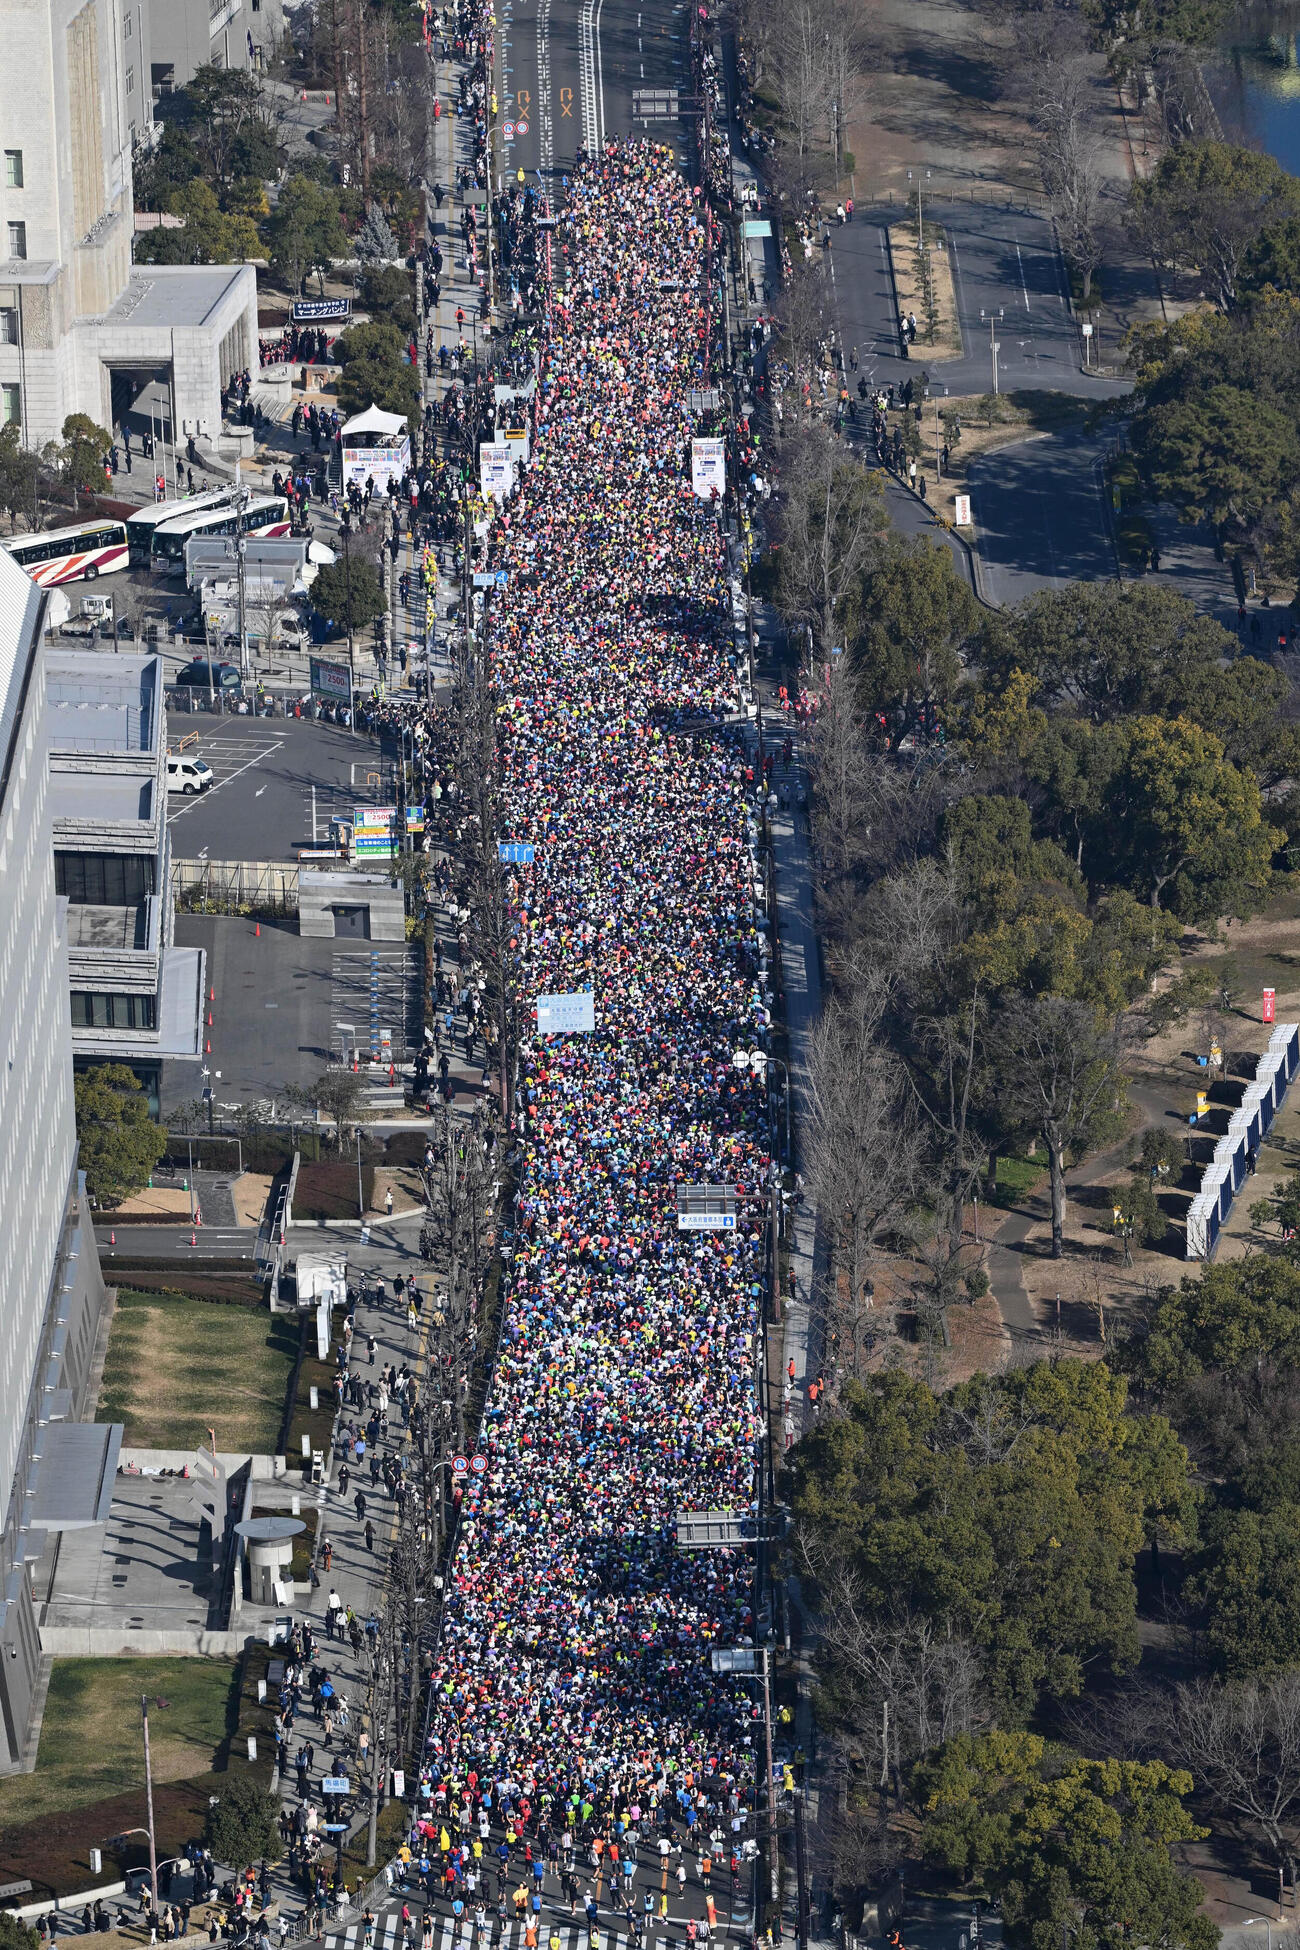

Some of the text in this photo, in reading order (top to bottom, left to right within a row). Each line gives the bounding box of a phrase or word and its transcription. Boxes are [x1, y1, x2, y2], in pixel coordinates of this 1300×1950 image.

[298, 306, 344, 316] マーチングバンド
[328, 674, 344, 686] 2500
[474, 1460, 484, 1468] 50
